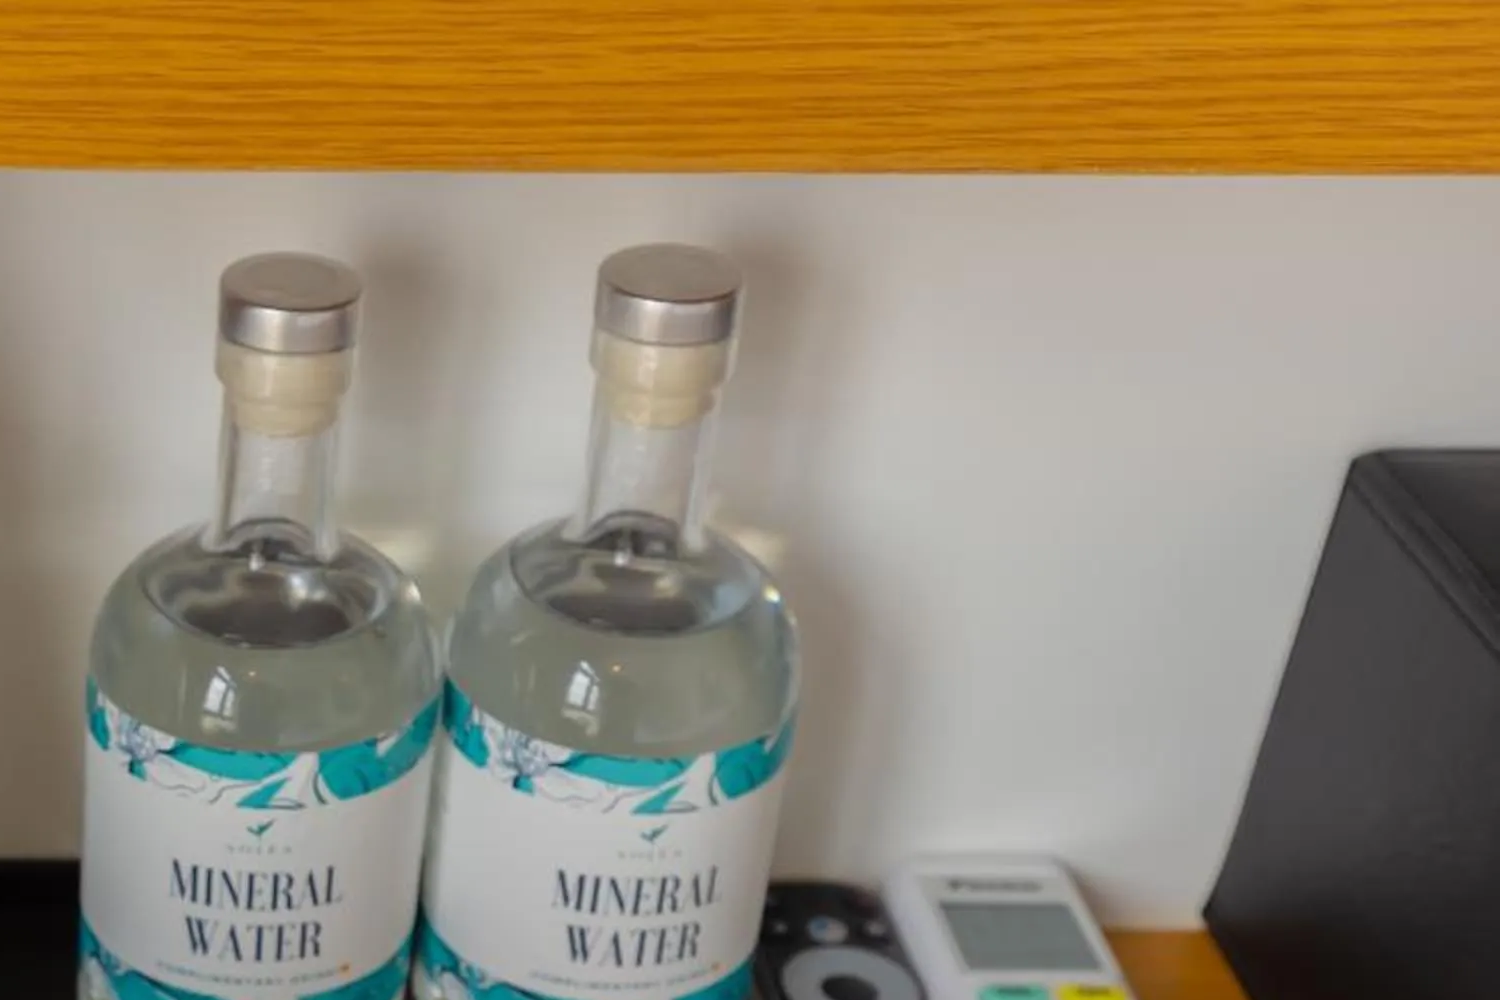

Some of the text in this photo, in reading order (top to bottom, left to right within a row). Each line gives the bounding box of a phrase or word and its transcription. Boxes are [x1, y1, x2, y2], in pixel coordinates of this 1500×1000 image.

[169, 857, 343, 912] MINERAL
[552, 863, 722, 917] MINERAL
[185, 914, 322, 963] WATER
[567, 920, 701, 968] WATER
